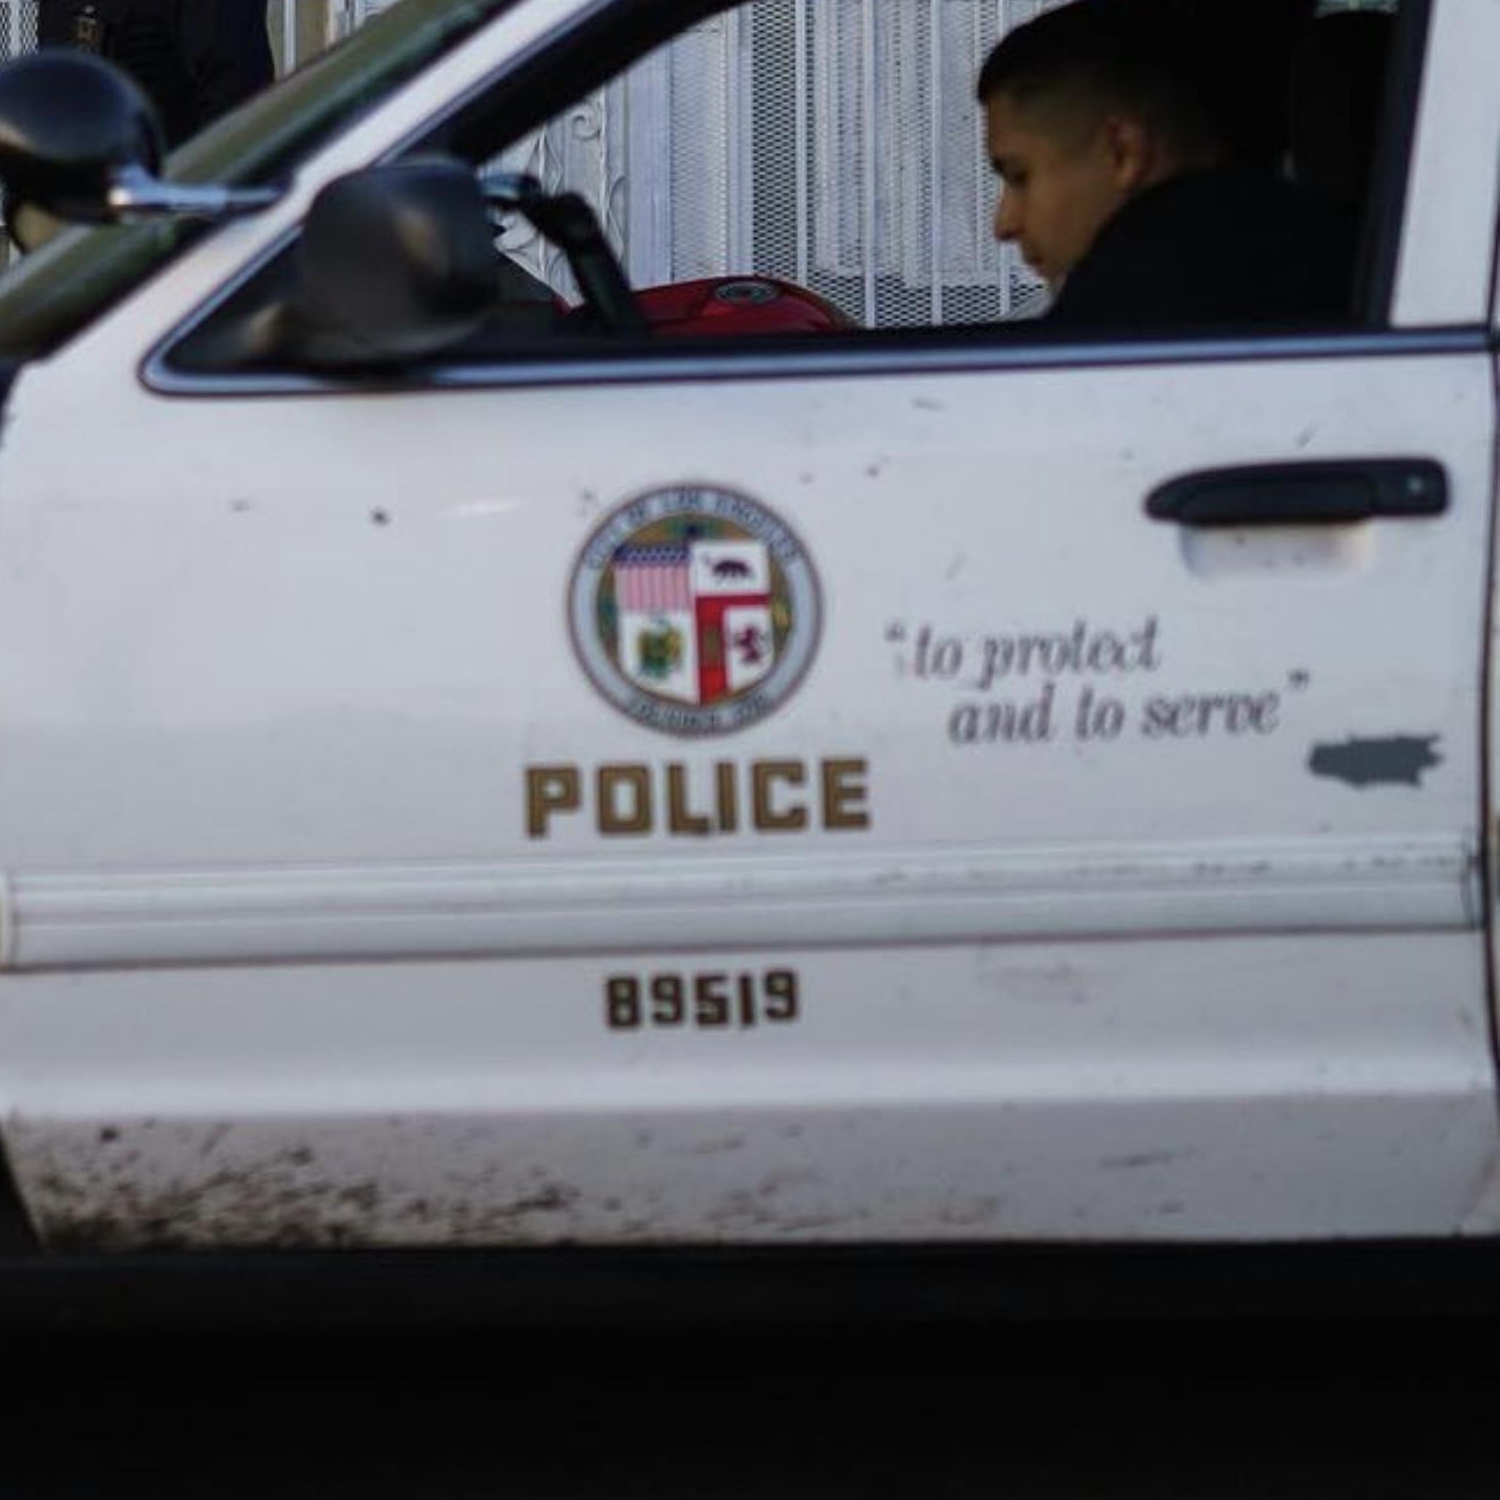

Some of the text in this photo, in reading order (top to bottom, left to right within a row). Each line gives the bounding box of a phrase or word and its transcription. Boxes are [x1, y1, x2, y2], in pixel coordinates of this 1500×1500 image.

[977, 615, 1161, 692] protect
[947, 681, 1056, 745] and
[1073, 686, 1125, 741] to
[524, 757, 871, 838] POLICE
[606, 970, 798, 1030] 89519
